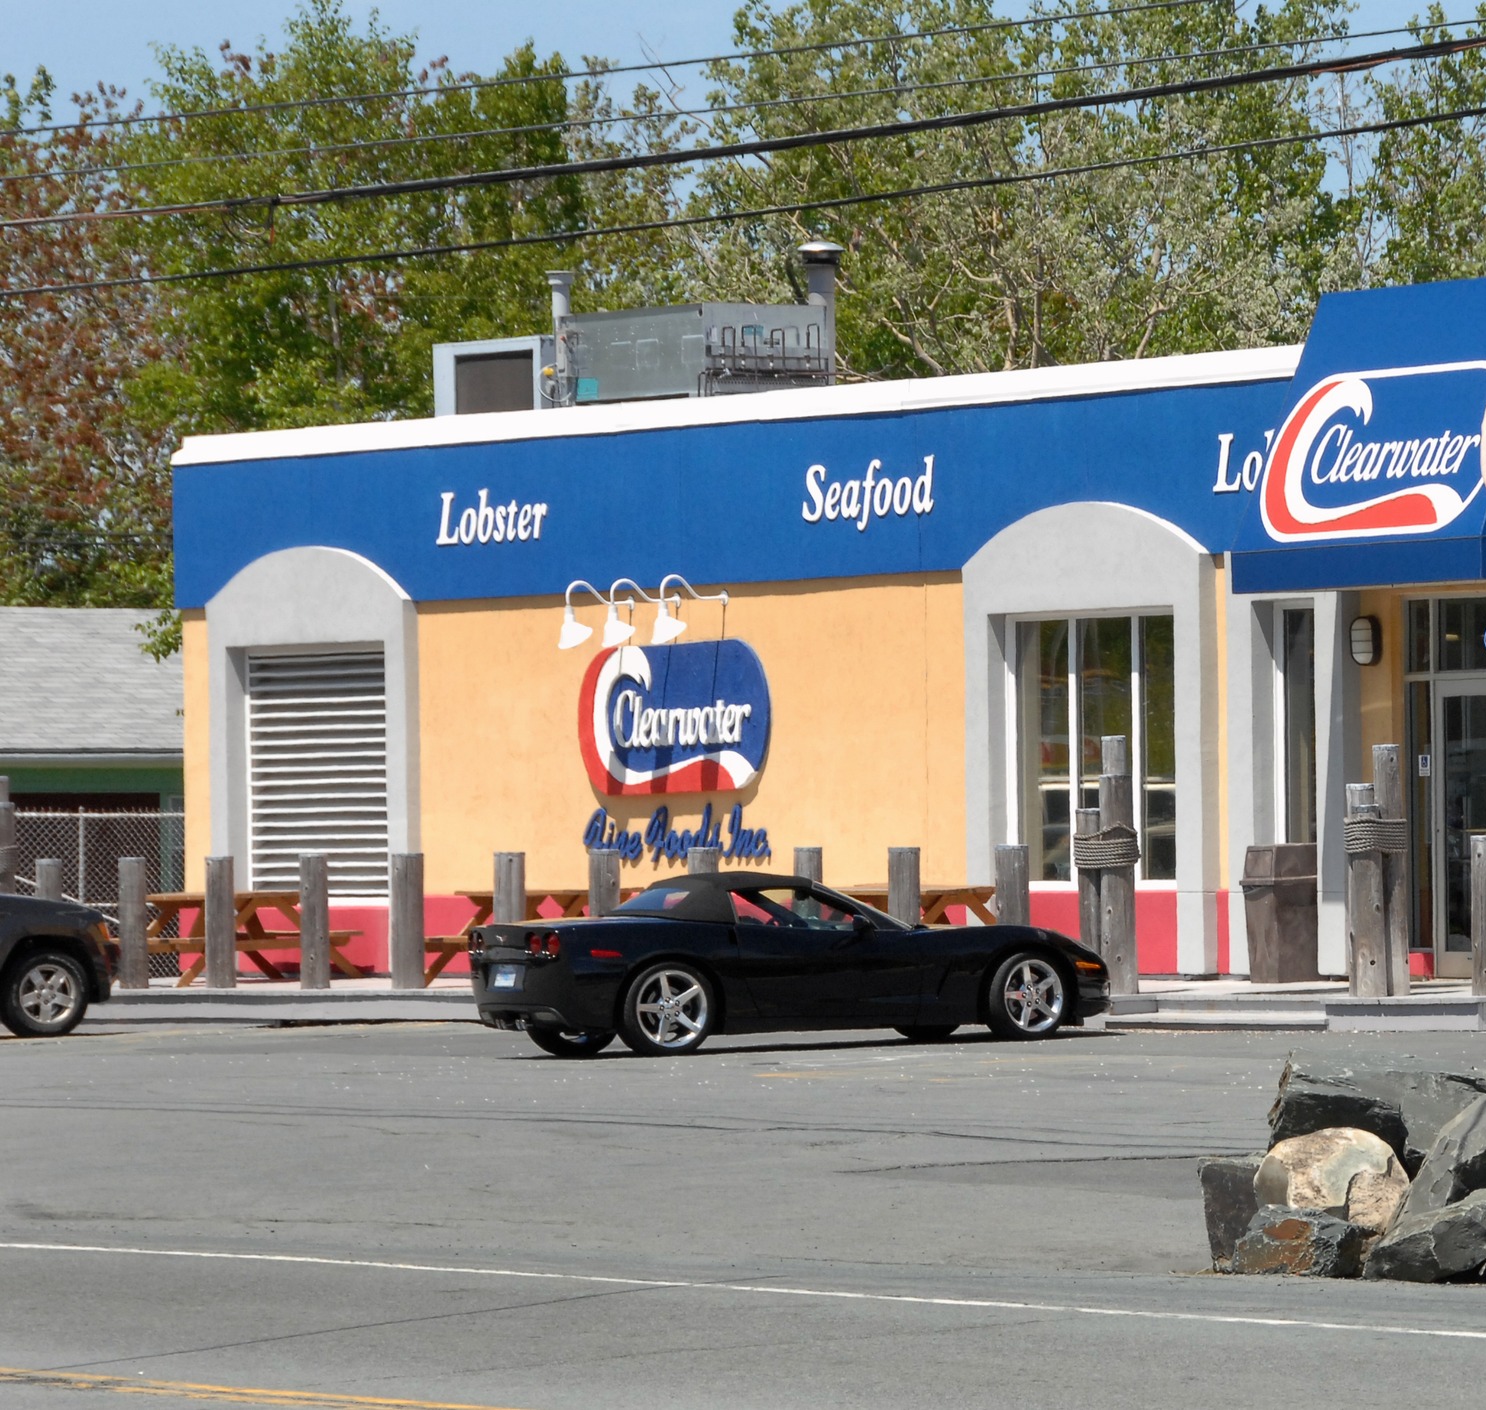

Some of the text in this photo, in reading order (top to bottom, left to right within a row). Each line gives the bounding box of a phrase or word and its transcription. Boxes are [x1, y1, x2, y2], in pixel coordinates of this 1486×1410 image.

[1212, 428, 1276, 492] Lo
[1310, 423, 1481, 485] Clearwater
[435, 488, 548, 546] Lobster
[802, 453, 935, 531] Seafood
[612, 689, 752, 749] Clearwater
